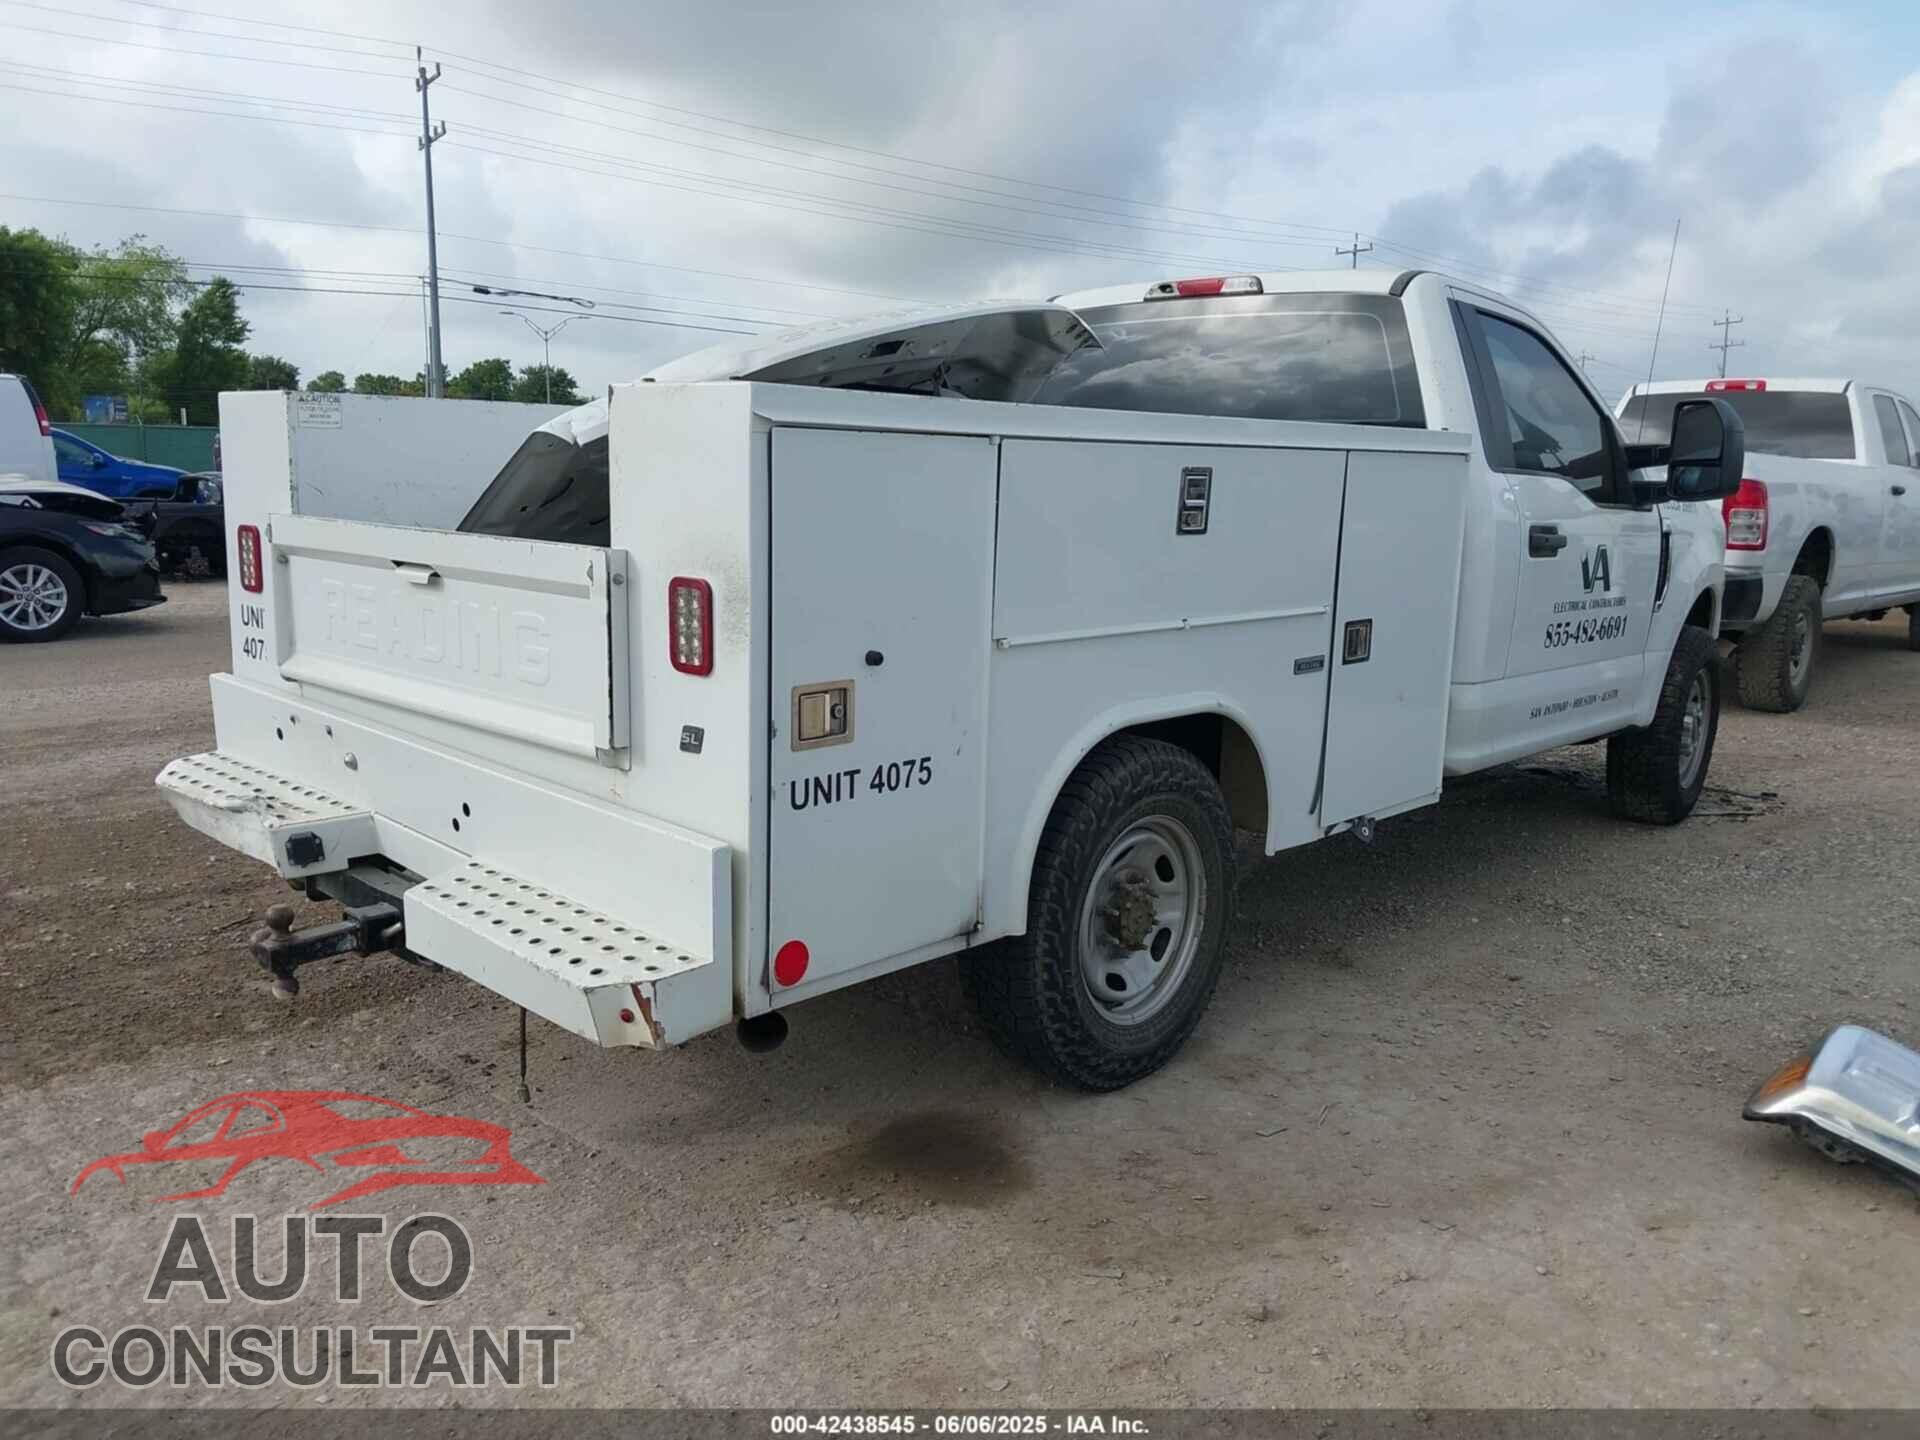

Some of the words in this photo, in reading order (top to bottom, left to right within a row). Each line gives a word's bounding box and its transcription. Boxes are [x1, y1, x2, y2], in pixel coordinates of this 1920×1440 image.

[241, 604, 265, 629] UNI
[321, 577, 551, 687] READING
[1544, 615, 1628, 648] 855-482-6691
[243, 637, 264, 660] 407
[790, 769, 861, 810] UNIT
[869, 756, 932, 794] 4075
